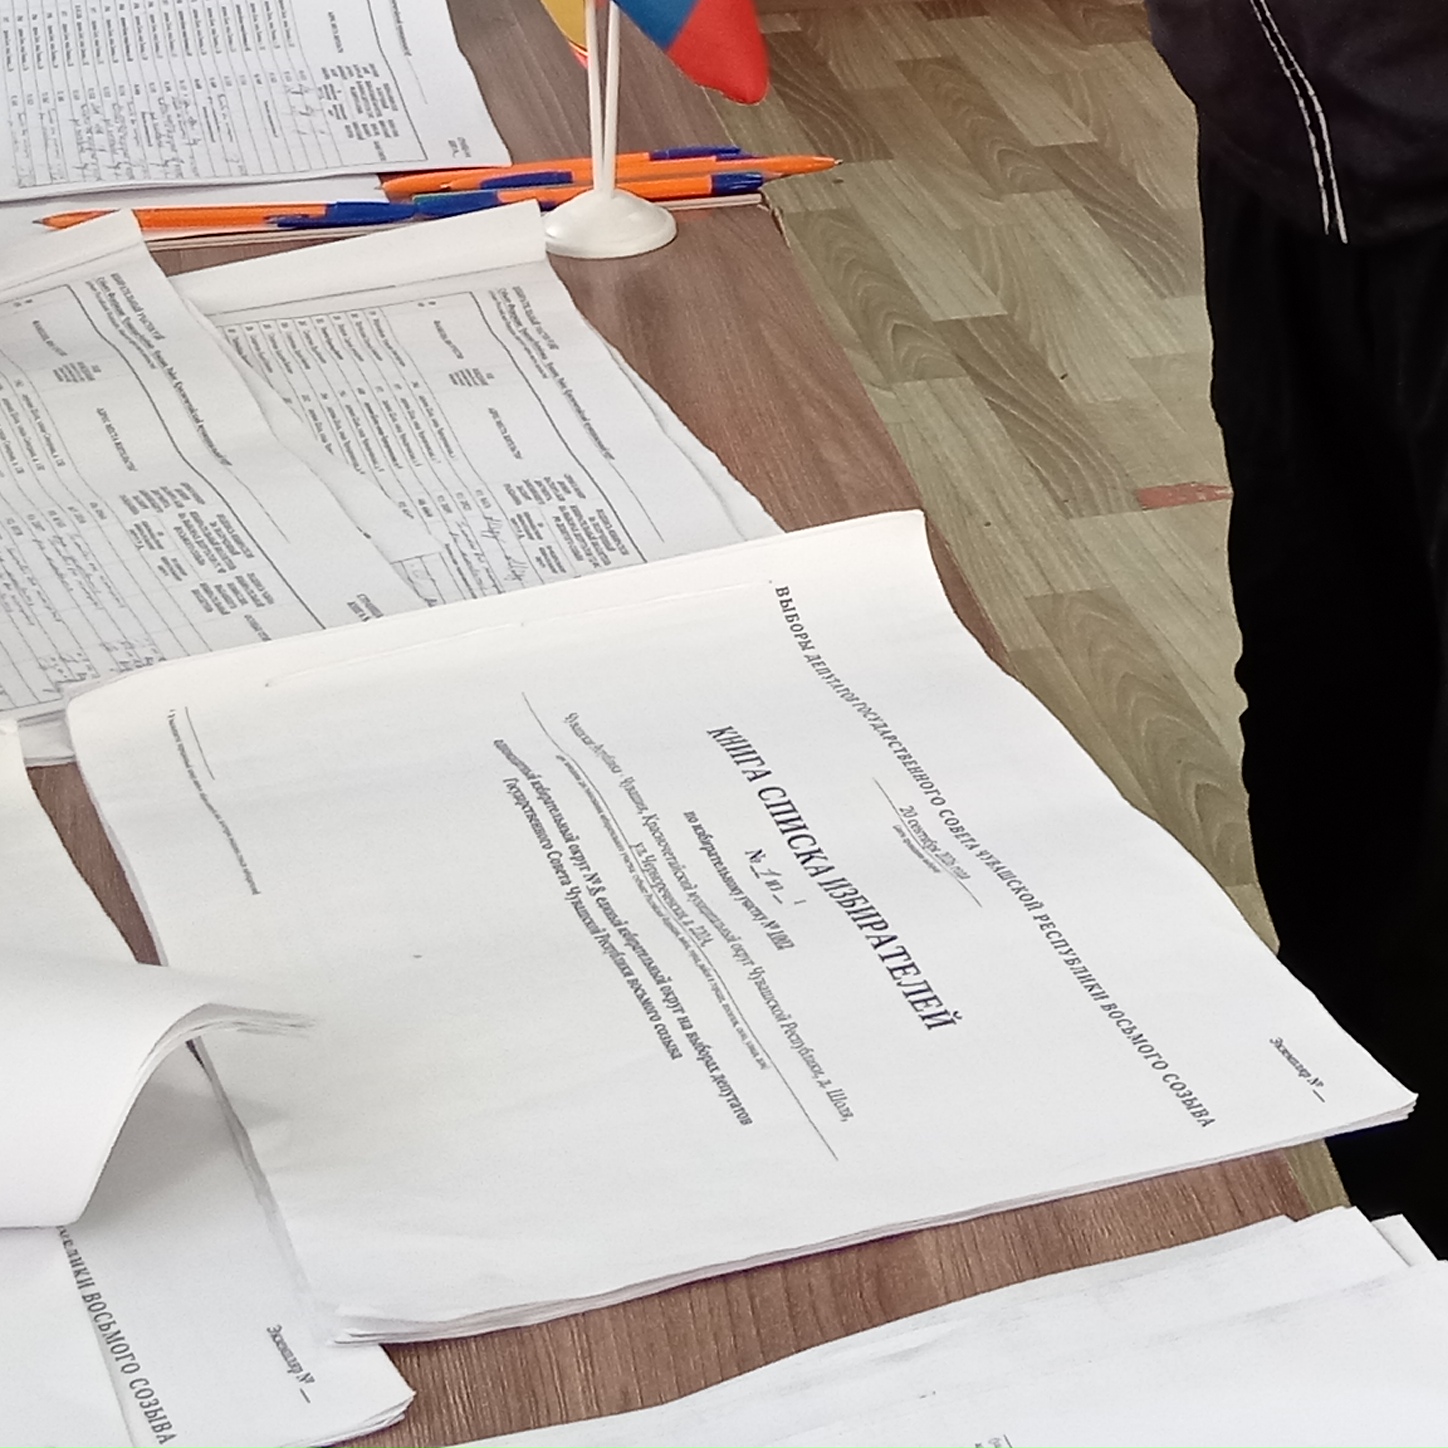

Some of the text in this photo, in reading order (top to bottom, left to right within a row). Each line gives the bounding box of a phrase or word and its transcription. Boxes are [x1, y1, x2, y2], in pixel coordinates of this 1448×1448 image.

[683, 811, 699, 823] по
[691, 823, 744, 900] избирательному
[733, 893, 769, 923] участку
[706, 725, 773, 783] КНИГА
[757, 786, 835, 878] СПИСКА
[816, 877, 963, 1031] ИЗБИРАТЕЛЕЙ
[775, 586, 815, 651] ВЫБОРЫ
[803, 654, 860, 705] ДЕПУТАТОВ
[852, 702, 946, 810] ГОСУДАРСТВЕННОГО
[938, 809, 981, 850] СОВЕТА
[975, 849, 1045, 912] ЧУВАШСКОЙ
[1032, 913, 1110, 1001] РЕСПУБЛИКИ
[1100, 1003, 1169, 1070] ВОСЬМОГО
[1162, 1073, 1216, 1128] СОЗЫВА
[899, 805, 918, 821] 20
[546, 850, 572, 886] Совета
[626, 977, 662, 1022] восьмого
[654, 1023, 683, 1060] созыва
[568, 844, 591, 875] округ
[659, 985, 686, 1018] округ
[676, 1016, 693, 1031] на
[685, 1031, 721, 1076] выборах
[709, 1070, 753, 1126] депутатов
[730, 939, 756, 966] округ
[747, 966, 792, 1025] Чувашской
[780, 1021, 825, 1079] Республики,
[86, 1292, 179, 1446] ВОСЬМОГО СОЗЫВА
